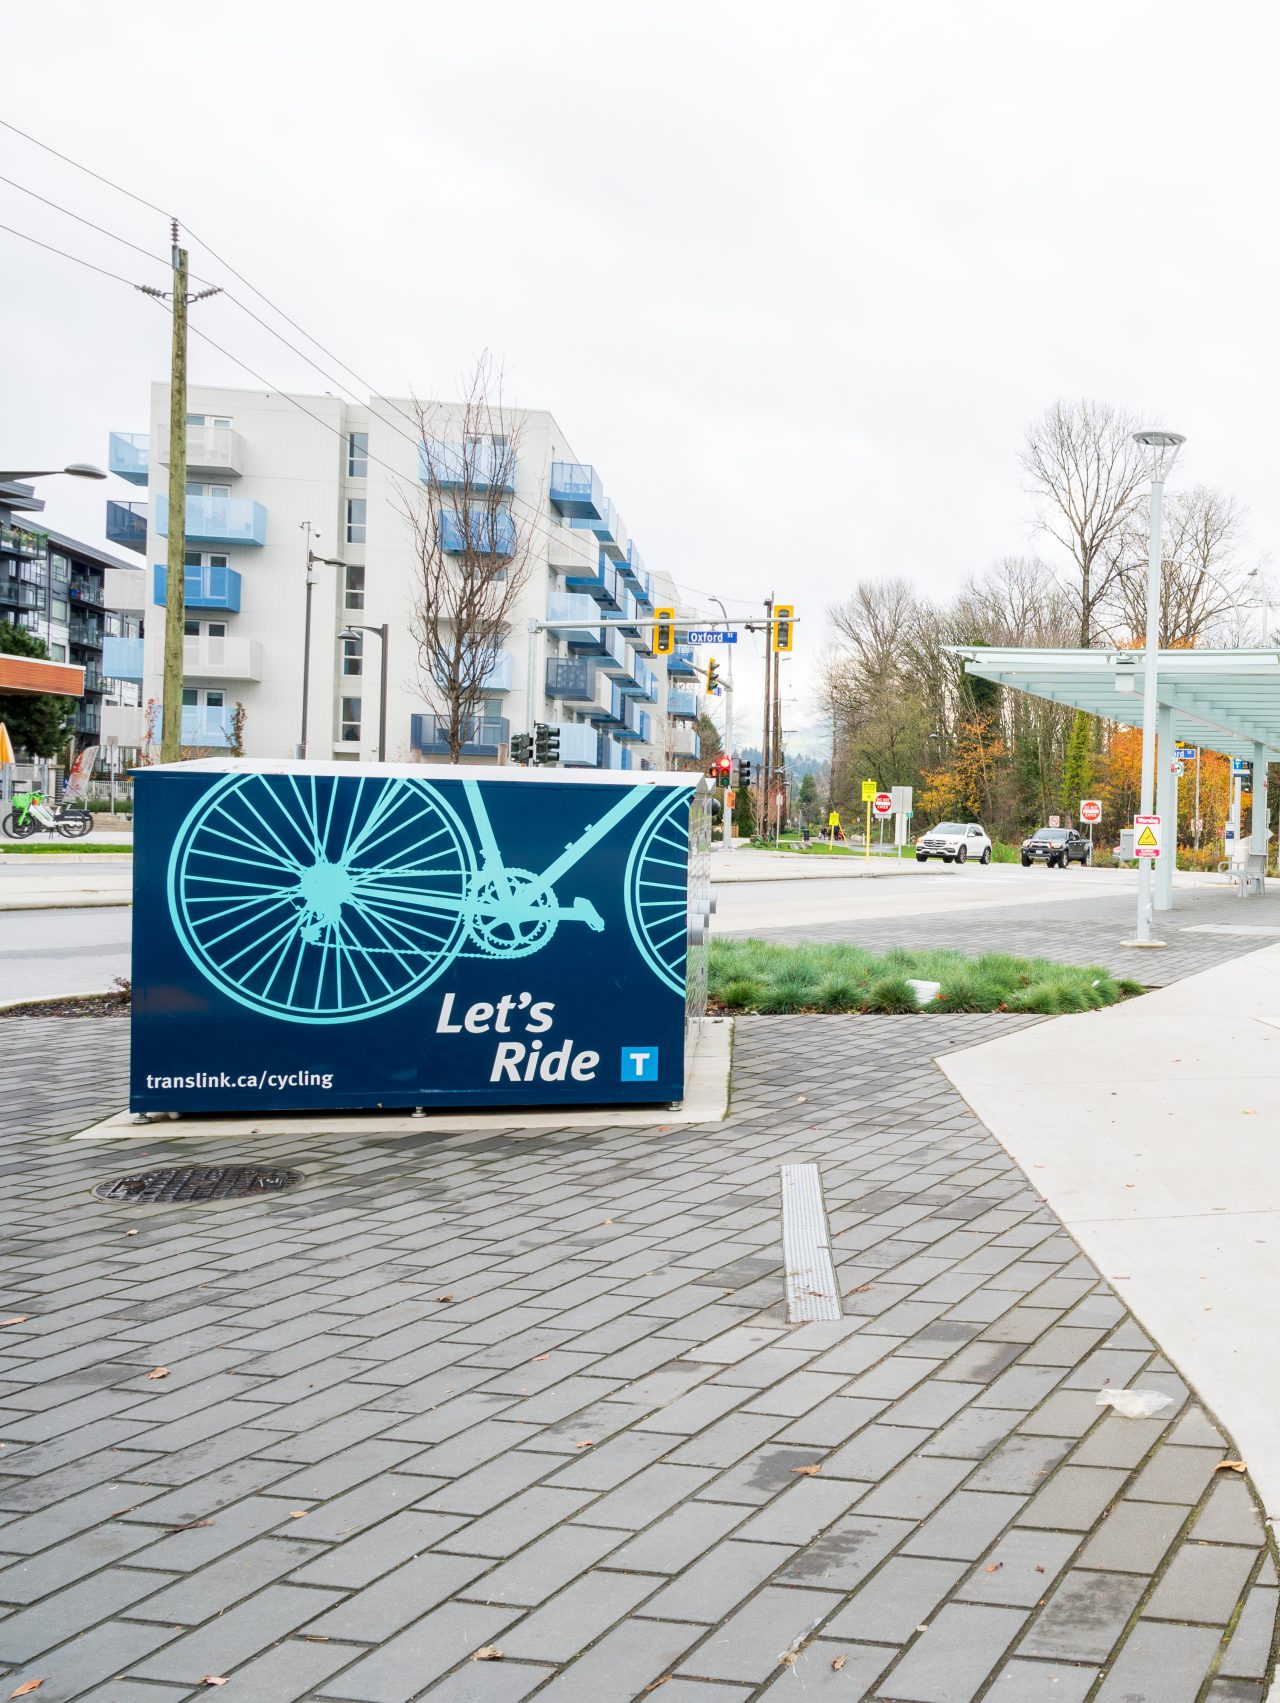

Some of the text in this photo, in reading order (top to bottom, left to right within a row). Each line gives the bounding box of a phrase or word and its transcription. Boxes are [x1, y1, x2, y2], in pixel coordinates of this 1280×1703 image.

[690, 632, 723, 643] Oxford
[436, 992, 555, 1034] Let's
[490, 1039, 600, 1082] Ride
[629, 1053, 650, 1076] T
[146, 1070, 334, 1090] translink.ca/cycling
